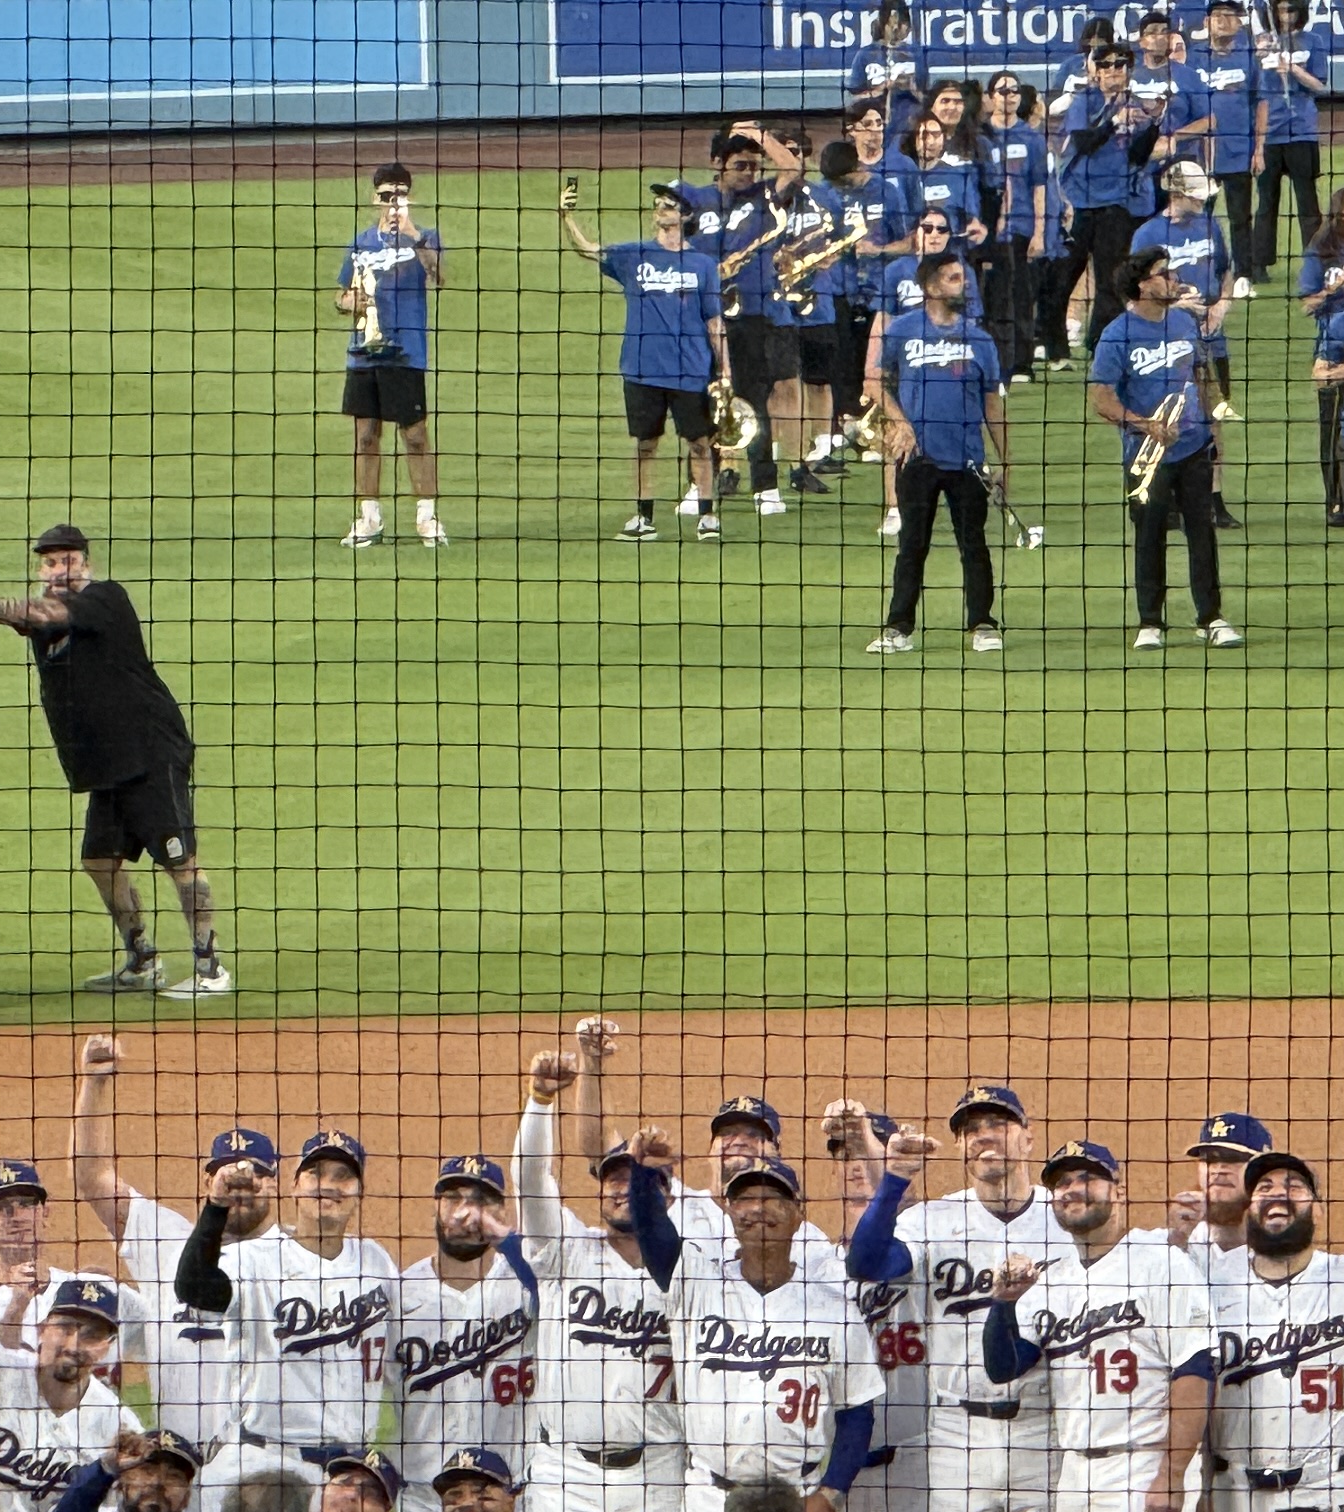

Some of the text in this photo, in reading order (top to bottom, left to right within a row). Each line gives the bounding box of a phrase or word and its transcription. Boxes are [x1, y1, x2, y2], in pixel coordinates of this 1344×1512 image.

[274, 1284, 390, 1357] Dodgers
[396, 1308, 532, 1394] Dodgers
[695, 1314, 831, 1382] Dodgers
[1030, 1298, 1146, 1360] Dodgers
[776, 1378, 822, 1428] 30
[1091, 1349, 1139, 1396] 13
